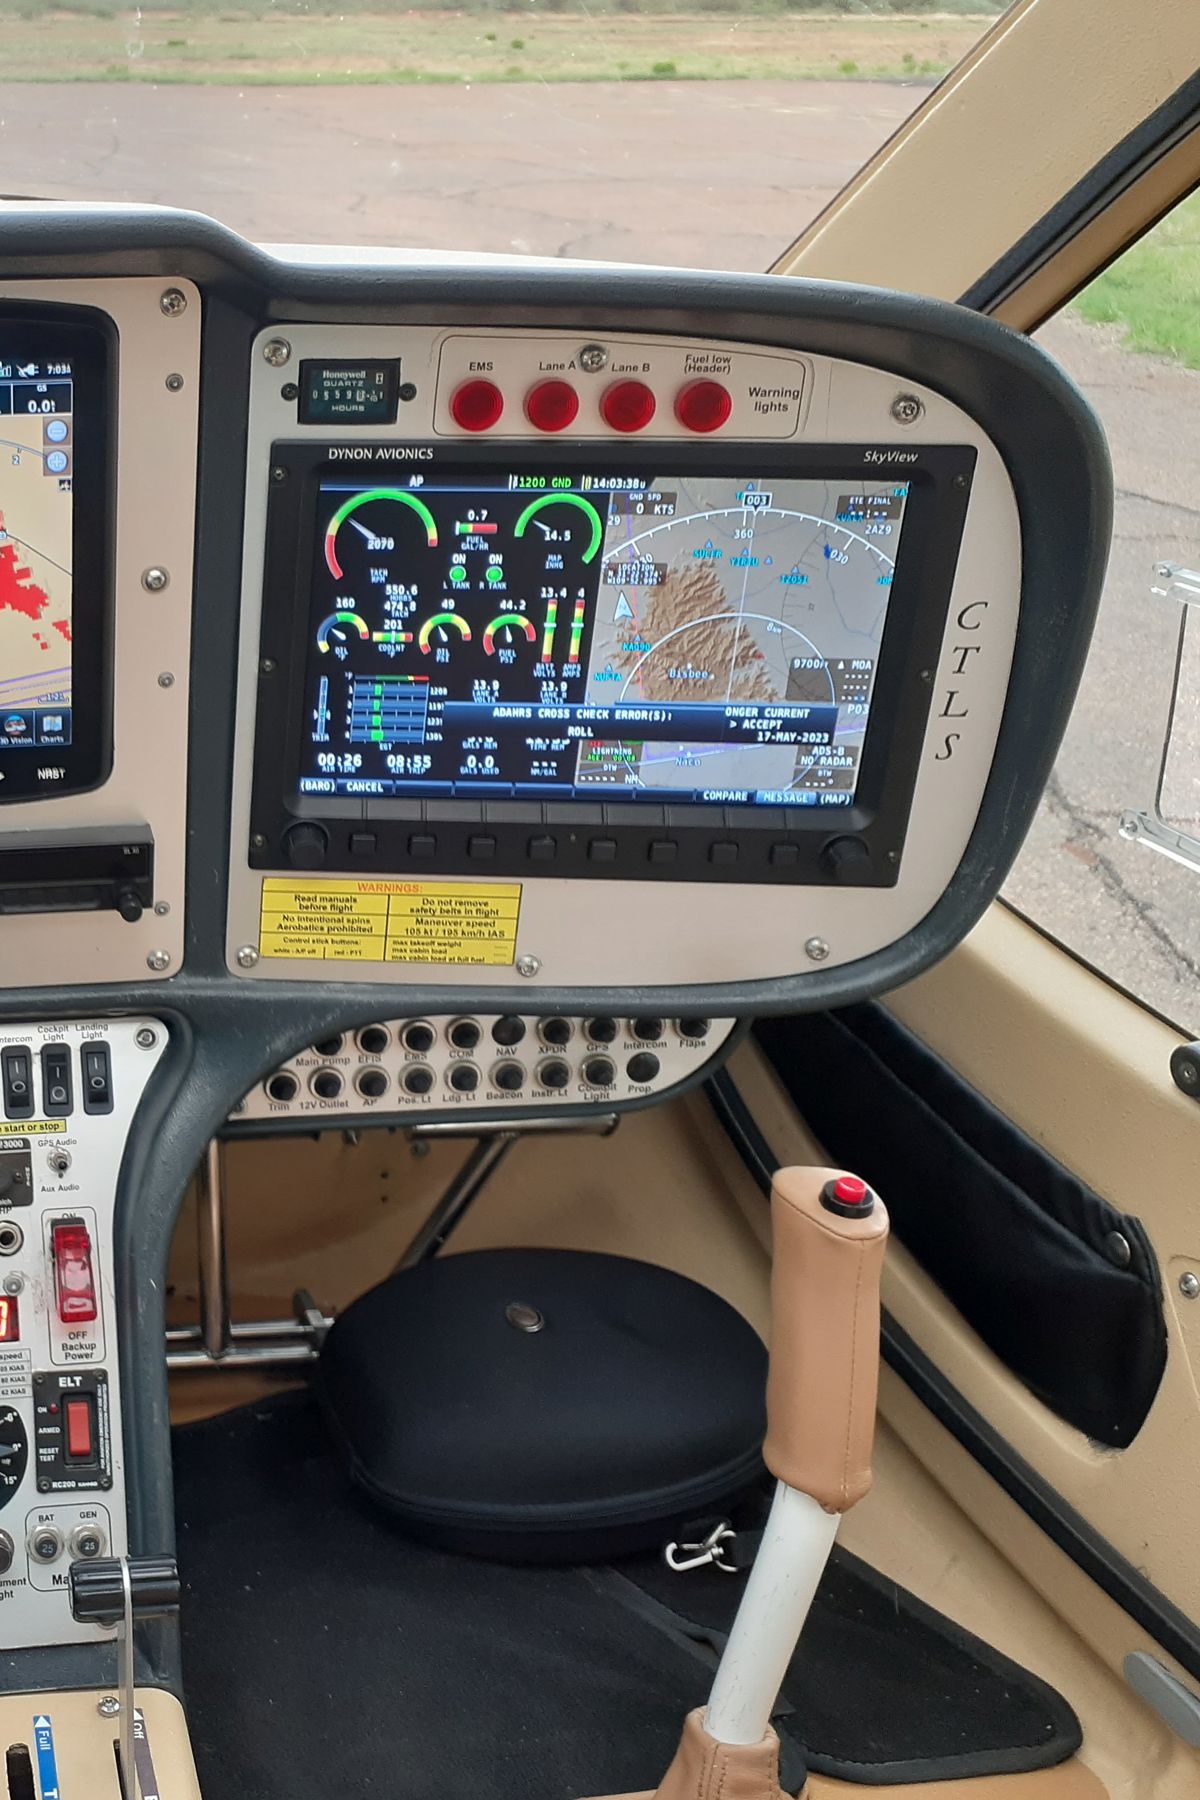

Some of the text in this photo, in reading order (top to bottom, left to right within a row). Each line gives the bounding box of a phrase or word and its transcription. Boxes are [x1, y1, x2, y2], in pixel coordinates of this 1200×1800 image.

[685, 355, 732, 365] Fuel low
[469, 362, 493, 371] EMS
[539, 361, 576, 371] Lane A
[612, 363, 650, 373] Lane B
[684, 363, 731, 375] (Header)
[323, 370, 366, 380] Honeywell
[749, 387, 800, 400] Warning
[754, 401, 789, 414] lights
[329, 449, 433, 460] DYNON AVIONICS
[863, 451, 919, 464] SkyView
[410, 476, 424, 487] AP
[519, 478, 545, 488] 1200
[552, 478, 572, 488] GND
[468, 510, 487, 522] 0.7
[544, 530, 571, 541] 14.5
[734, 528, 754, 540] 360
[452, 554, 466, 565] ON
[489, 554, 503, 565] ON
[500, 600, 526, 611] 44.2
[852, 660, 872, 670] MOA
[493, 707, 532, 719] ADAHRS
[538, 708, 570, 719] CROSS
[576, 709, 609, 720] CHECK
[764, 708, 810, 719] CURRENT
[743, 720, 782, 731] ACCEPT
[568, 726, 594, 737] ROLL
[757, 731, 829, 743] 17-MAY-2023
[318, 754, 362, 768] 00:26
[387, 755, 432, 769] 08:55
[801, 756, 853, 767] NO RADAR
[37, 768, 66, 780] NRST
[300, 780, 384, 793] (BARO) CANCEL
[703, 791, 850, 806] COMPARE MESSAGE (MAP)
[357, 882, 422, 893] WARNINGS:
[294, 894, 357, 904] Read manuals
[299, 902, 353, 914] before flight
[277, 923, 373, 935] Aerobatics prohibited
[415, 918, 496, 930] Maneuver speed
[37, 1025, 69, 1035] Cockpit
[75, 1022, 109, 1032] Landing
[43, 1033, 64, 1042] Light
[81, 1030, 103, 1040] Light
[624, 1040, 667, 1050] Intercom
[679, 1039, 706, 1048] Flaps
[404, 1053, 427, 1061] EMS
[449, 1051, 474, 1059] COM
[496, 1047, 518, 1056] NAV
[296, 1056, 350, 1067] Main Pump
[578, 1083, 617, 1093] Cockpit
[486, 1091, 523, 1100] Beacon
[584, 1091, 610, 1101] Light
[269, 1102, 290, 1111] Trim
[300, 1100, 349, 1110] 12V Outlet
[6, 1124, 25, 1134] start
[28, 1124, 37, 1132] or
[39, 1122, 60, 1132] stop
[38, 1138, 77, 1147] GPS Audio
[41, 1183, 80, 1193] Aux Audio
[68, 1331, 87, 1340] OFF
[62, 1342, 96, 1353] Backup
[64, 1351, 94, 1361] Power
[59, 1376, 82, 1387] ELT
[38, 1513, 54, 1522] BAT
[80, 1511, 97, 1519] GEN
[42, 1544, 53, 1553] 25
[85, 1542, 95, 1551] 25
[133, 1722, 144, 1739] Off
[38, 1730, 51, 1750] Full
